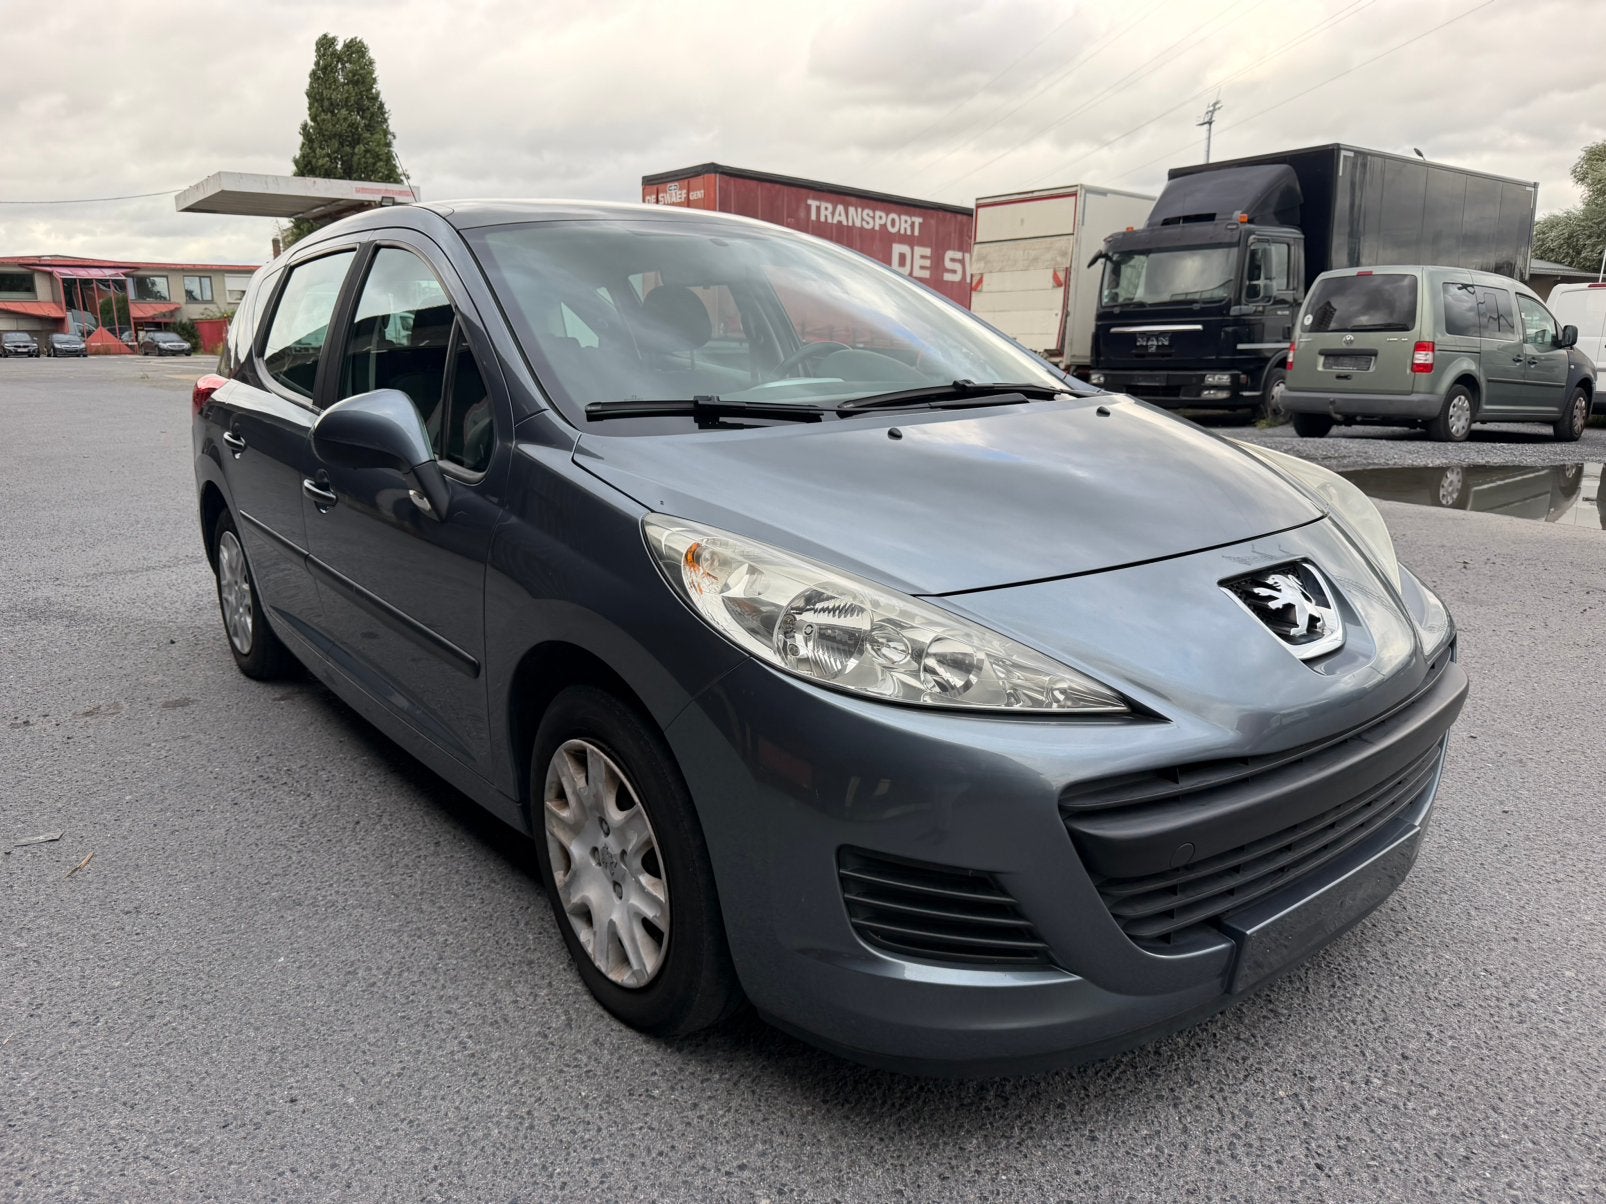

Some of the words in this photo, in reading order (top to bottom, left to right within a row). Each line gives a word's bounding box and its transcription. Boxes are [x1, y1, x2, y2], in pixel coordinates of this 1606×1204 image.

[807, 199, 923, 236] TRANSPORT
[892, 243, 931, 278] DE
[1136, 336, 1169, 346] MAN
